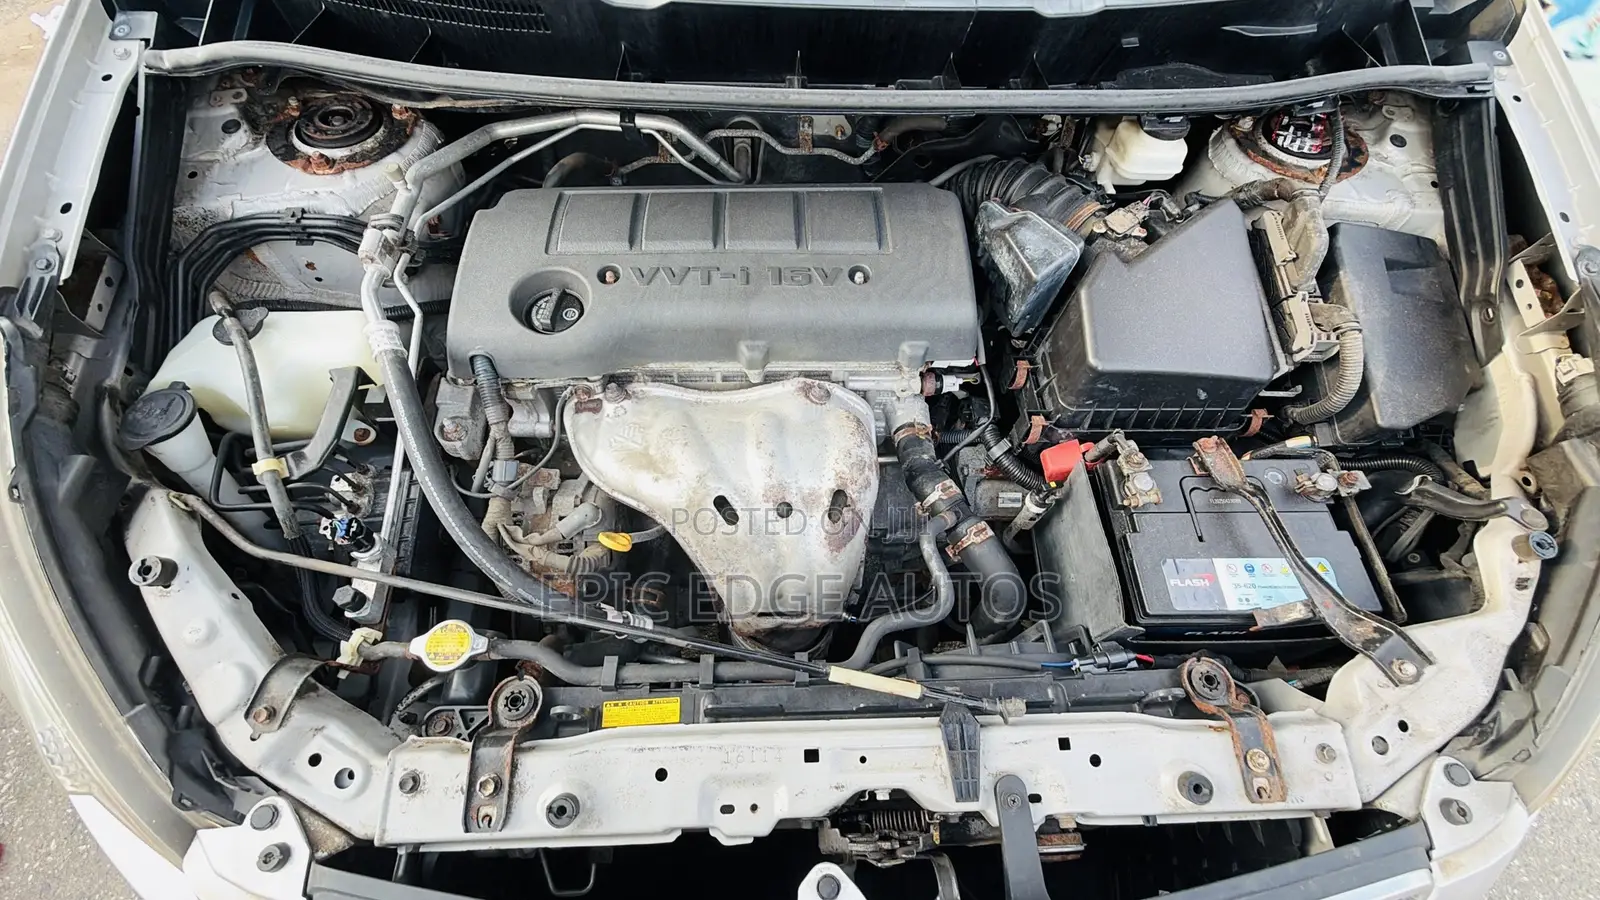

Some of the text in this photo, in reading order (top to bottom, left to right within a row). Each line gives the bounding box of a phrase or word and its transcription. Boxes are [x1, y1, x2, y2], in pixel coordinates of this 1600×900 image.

[628, 265, 846, 287] VVT-i 16V
[1169, 578, 1210, 587] FLASH
